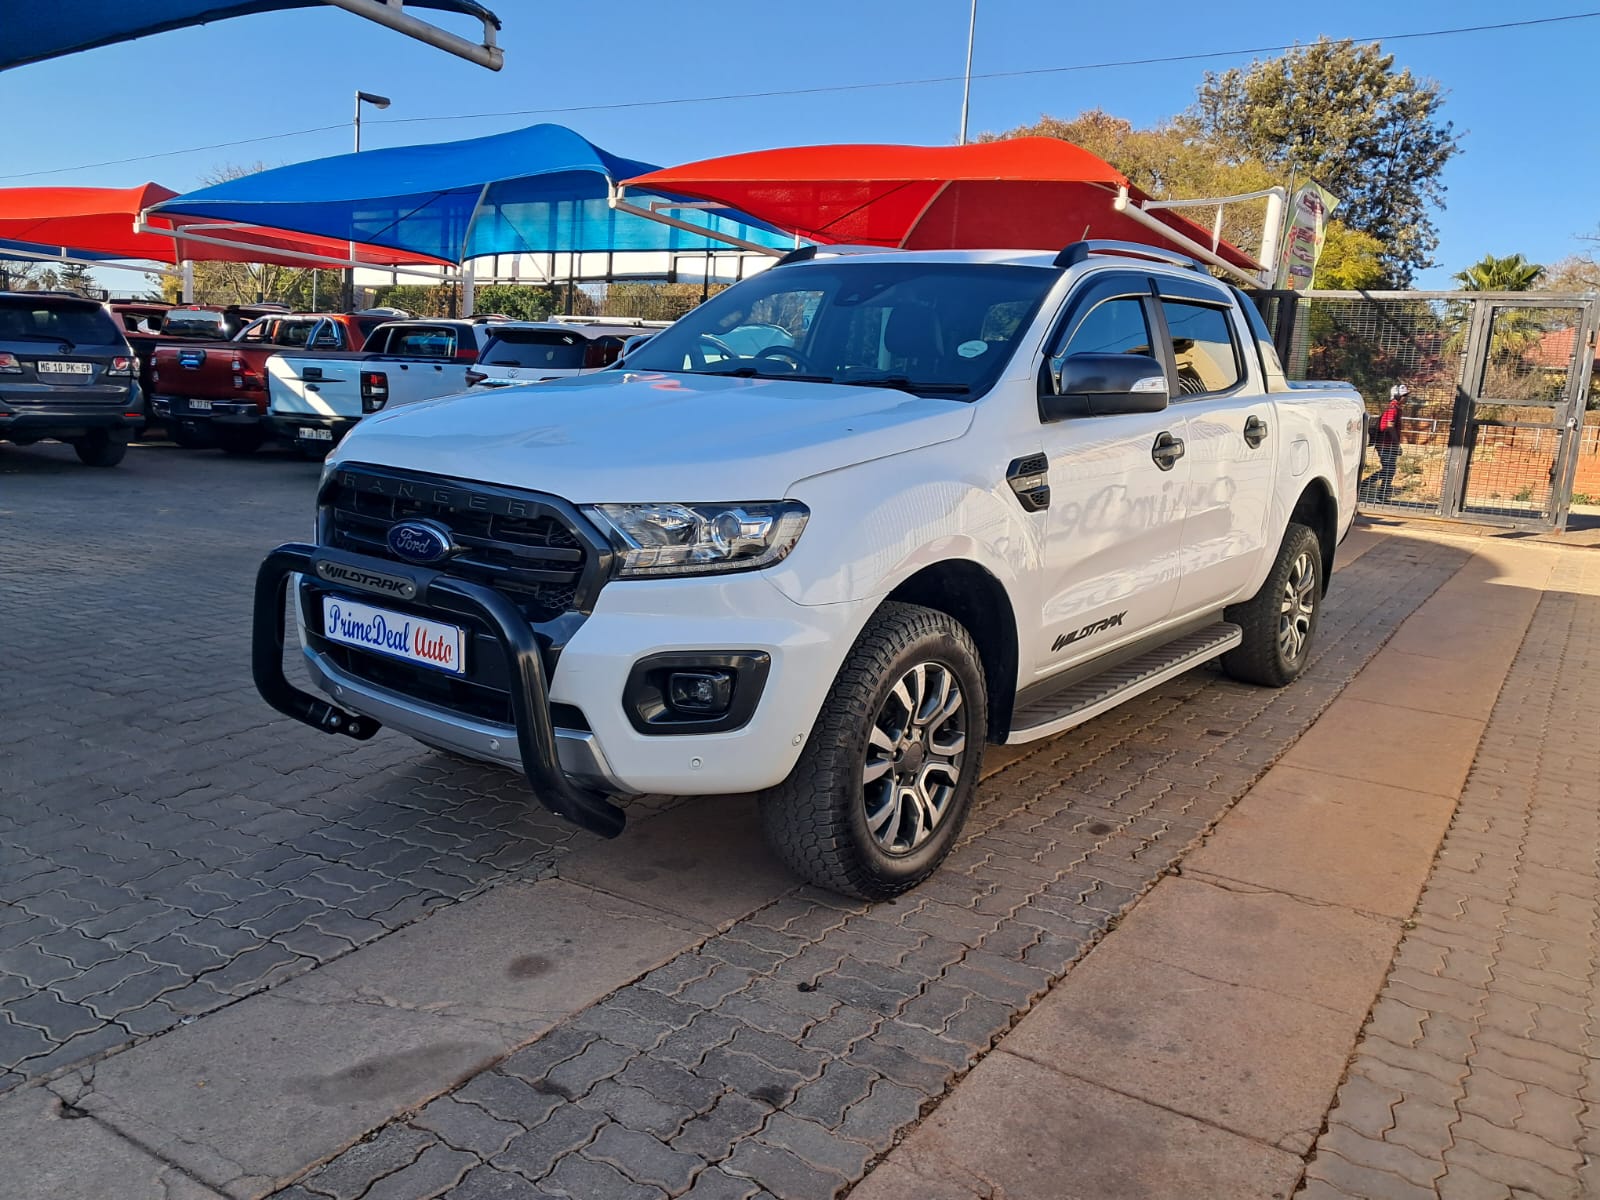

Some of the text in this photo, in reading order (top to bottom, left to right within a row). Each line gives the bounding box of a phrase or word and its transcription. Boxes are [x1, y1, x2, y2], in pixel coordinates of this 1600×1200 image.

[40, 362, 50, 372] MG
[344, 472, 528, 516] RANGER
[396, 528, 430, 554] Ford
[325, 562, 408, 595] WILDTRAK
[328, 604, 410, 653] PrimeDeal
[1051, 610, 1128, 652] WILDTRAK
